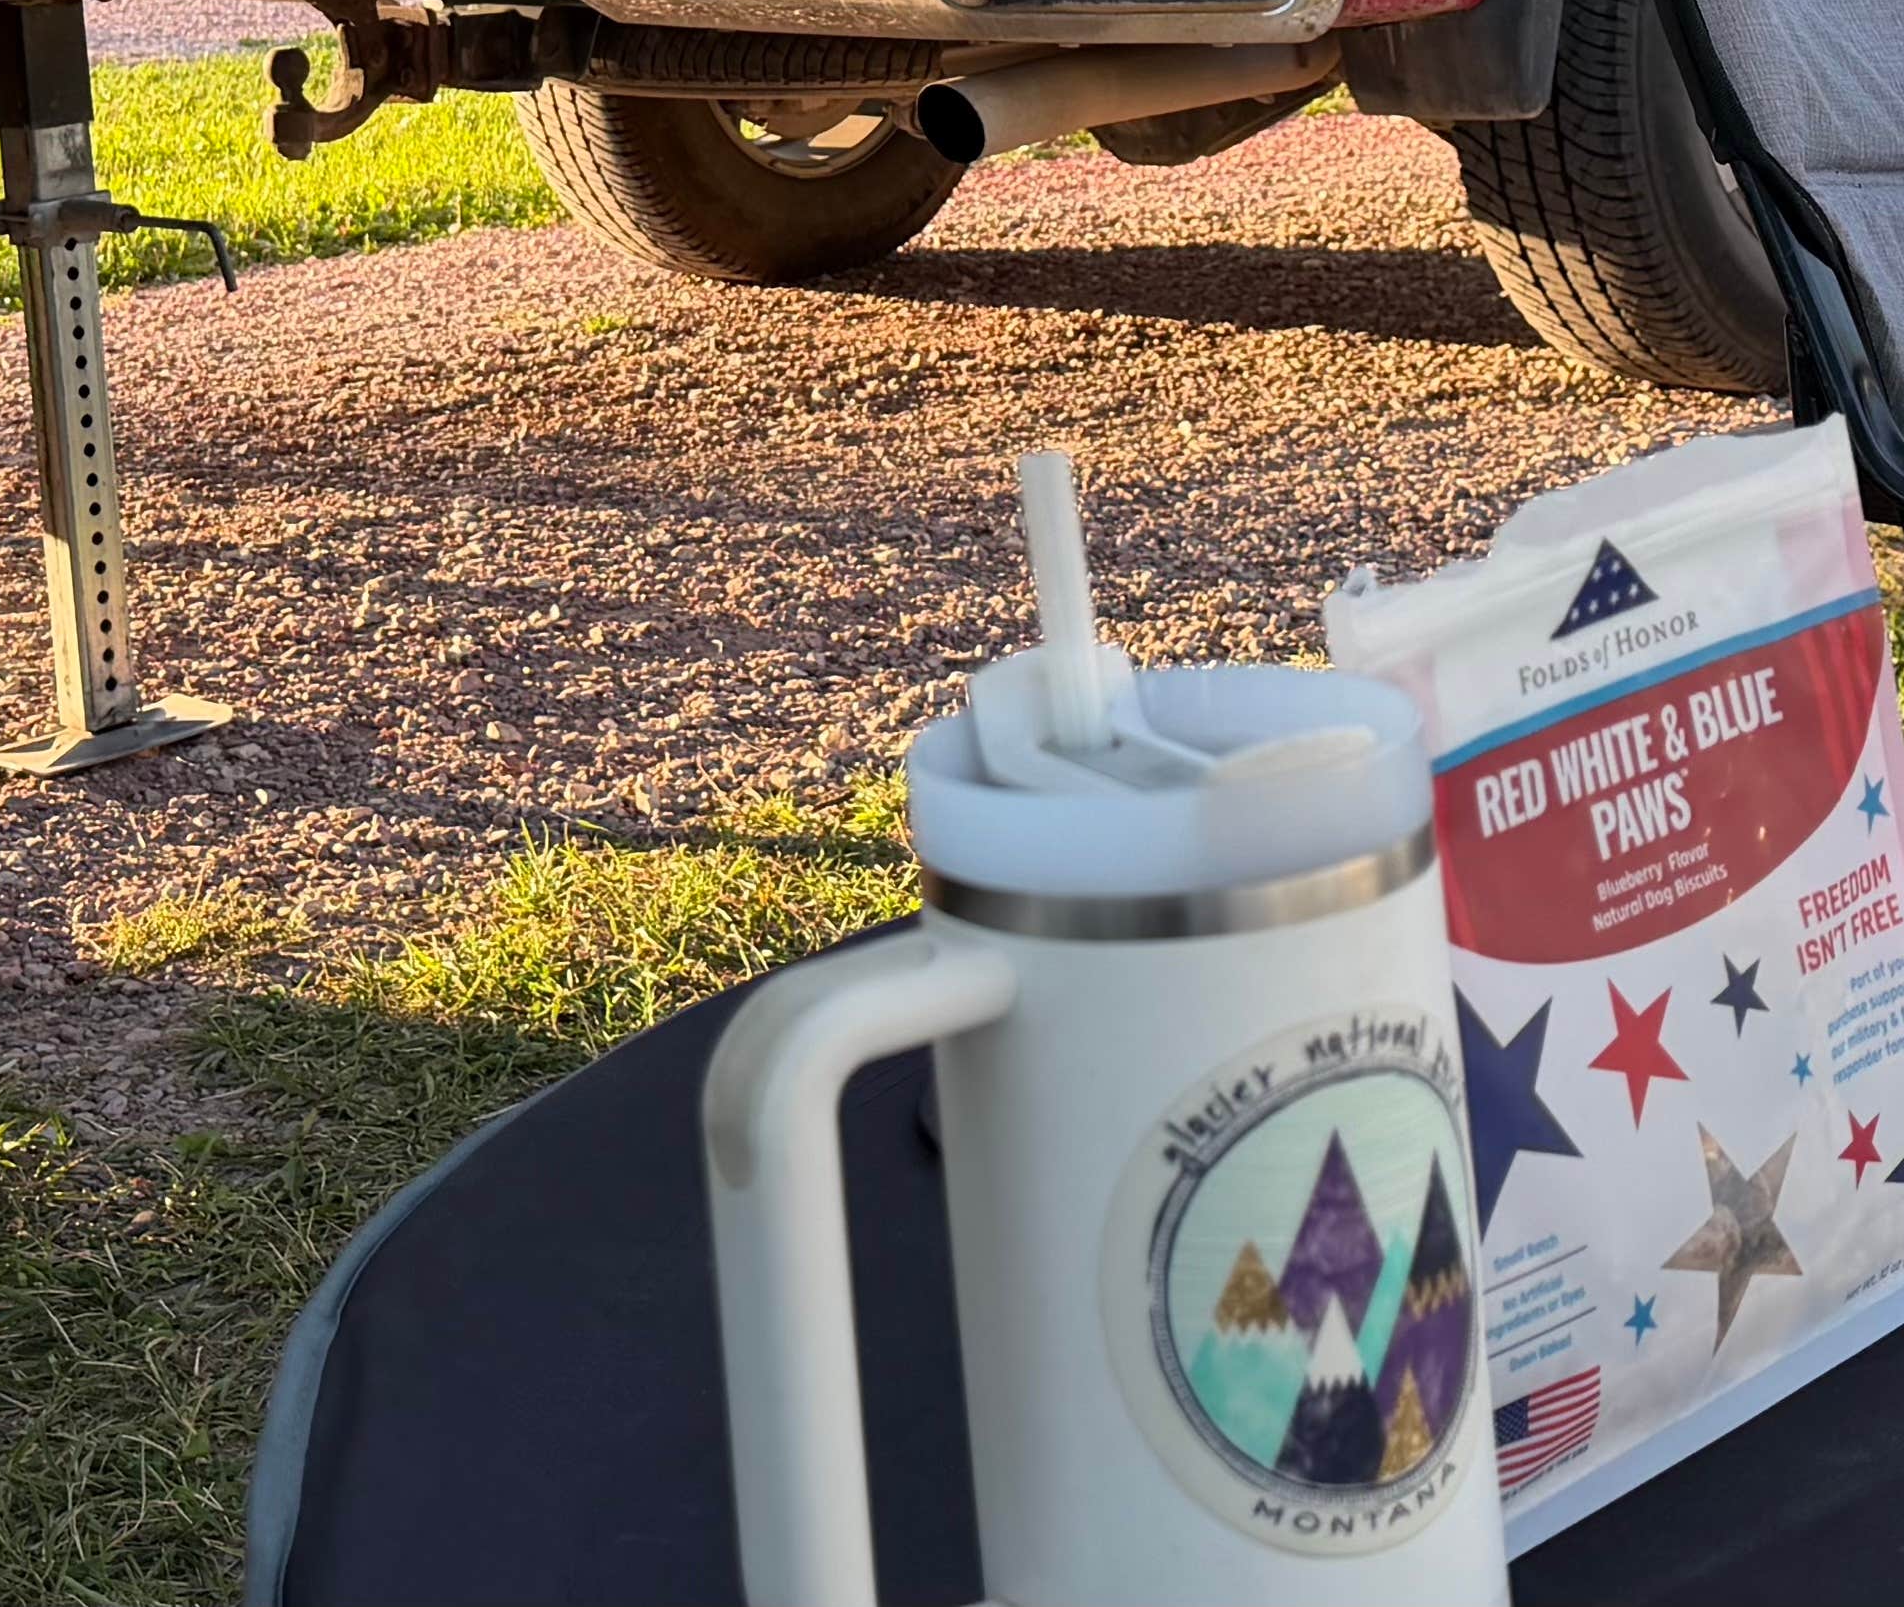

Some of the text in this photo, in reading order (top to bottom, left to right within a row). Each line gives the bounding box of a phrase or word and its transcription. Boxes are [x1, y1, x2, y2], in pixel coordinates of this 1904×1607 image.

[1593, 638, 1613, 670] of
[1475, 668, 1784, 838] RED WHITE & BLUE
[1592, 865, 1728, 933] Natural Dog Biscuits
[1597, 841, 1710, 901] Blueberry Flavor
[1798, 854, 1891, 929] FREEDOM
[1796, 894, 1904, 976] ISN'T FREE
[1873, 961, 1885, 980] of
[1252, 1461, 1456, 1536] MONTANA
